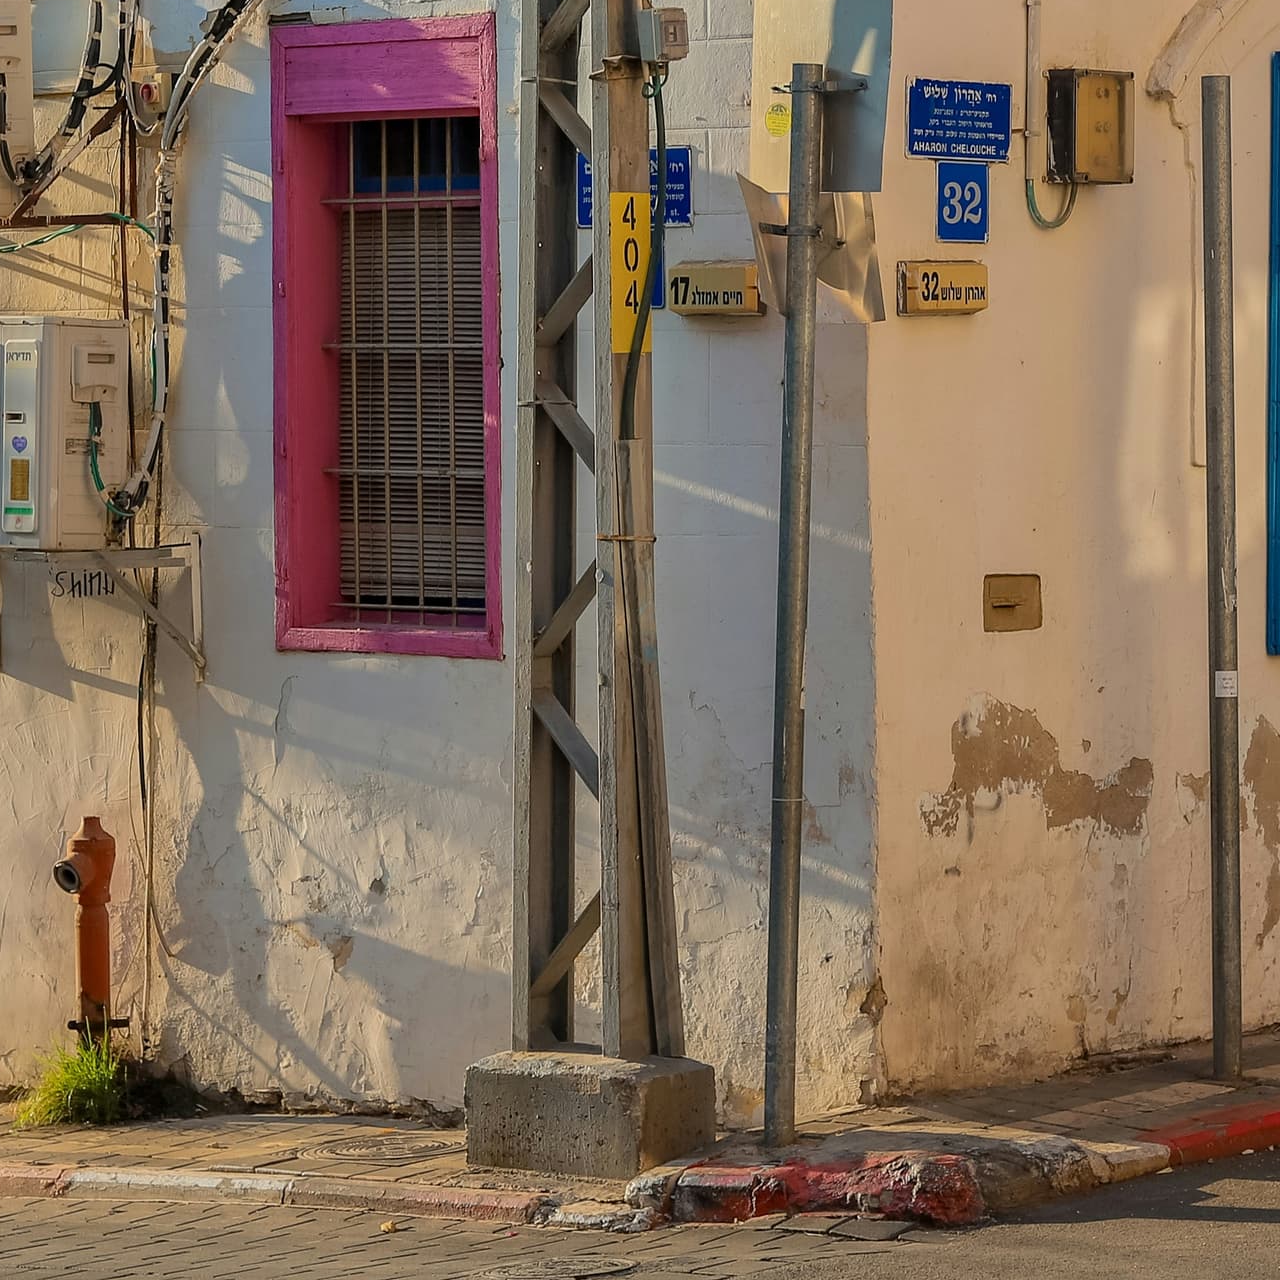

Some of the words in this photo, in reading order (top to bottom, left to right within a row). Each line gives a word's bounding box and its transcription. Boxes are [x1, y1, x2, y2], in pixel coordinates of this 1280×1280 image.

[913, 141, 947, 153] AHARON
[950, 143, 997, 155] CHELOUCHE
[942, 181, 982, 224] 32
[670, 277, 690, 305] 17
[691, 285, 719, 305] אמזלג
[921, 272, 939, 301] 32
[941, 281, 962, 301] שלוש
[965, 285, 986, 304] אהרון
[723, 291, 743, 305] חיים
